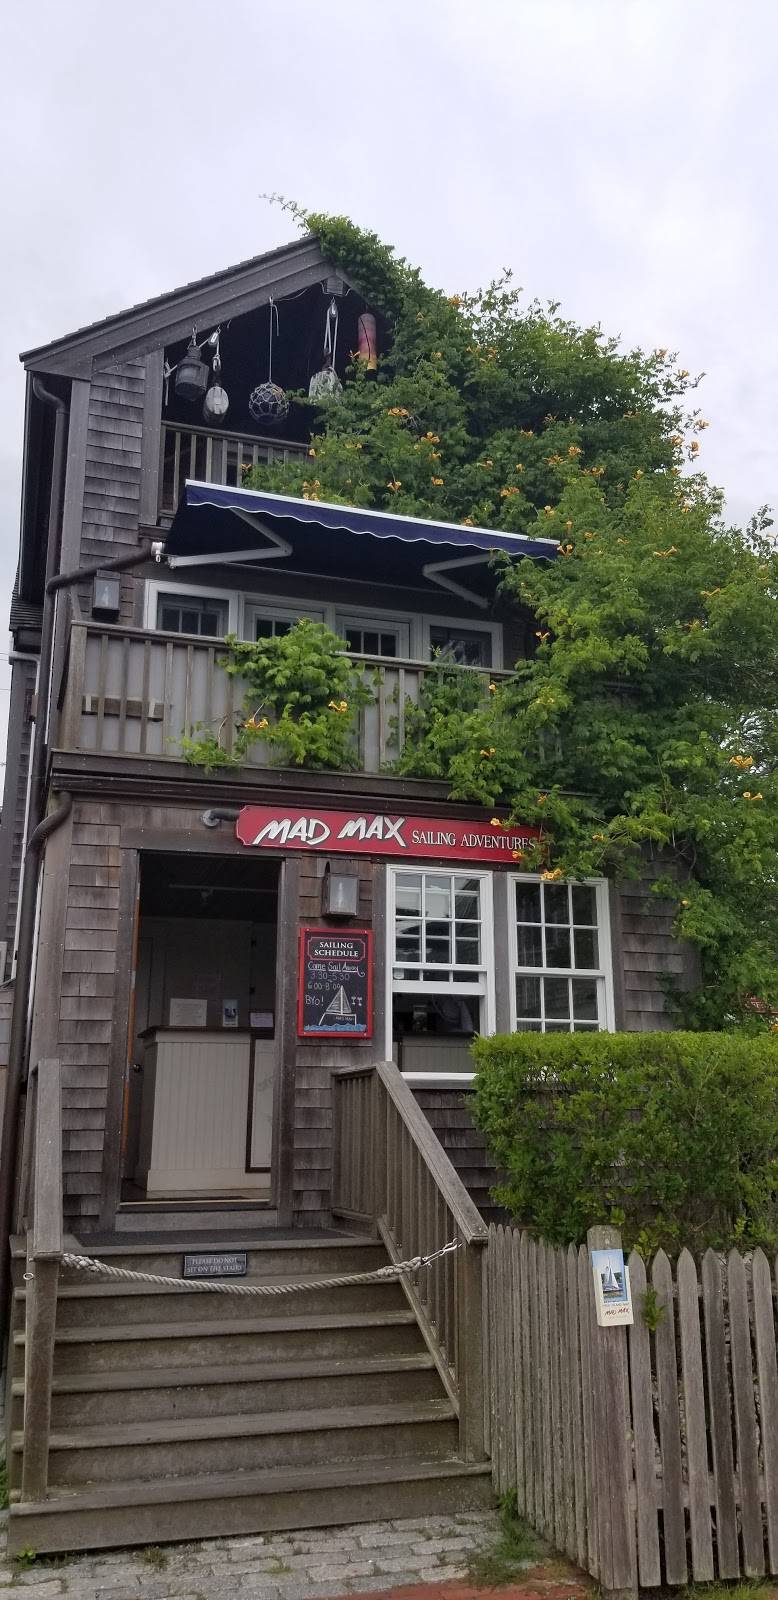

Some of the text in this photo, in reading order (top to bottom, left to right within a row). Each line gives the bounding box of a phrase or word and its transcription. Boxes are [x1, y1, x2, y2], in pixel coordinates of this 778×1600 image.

[251, 815, 406, 847] MAD MAX
[411, 830, 536, 850] SAILING ADVENTURES
[319, 941, 354, 949] SAILING
[314, 949, 359, 957] SCHEDULE
[328, 961, 341, 971] Sail
